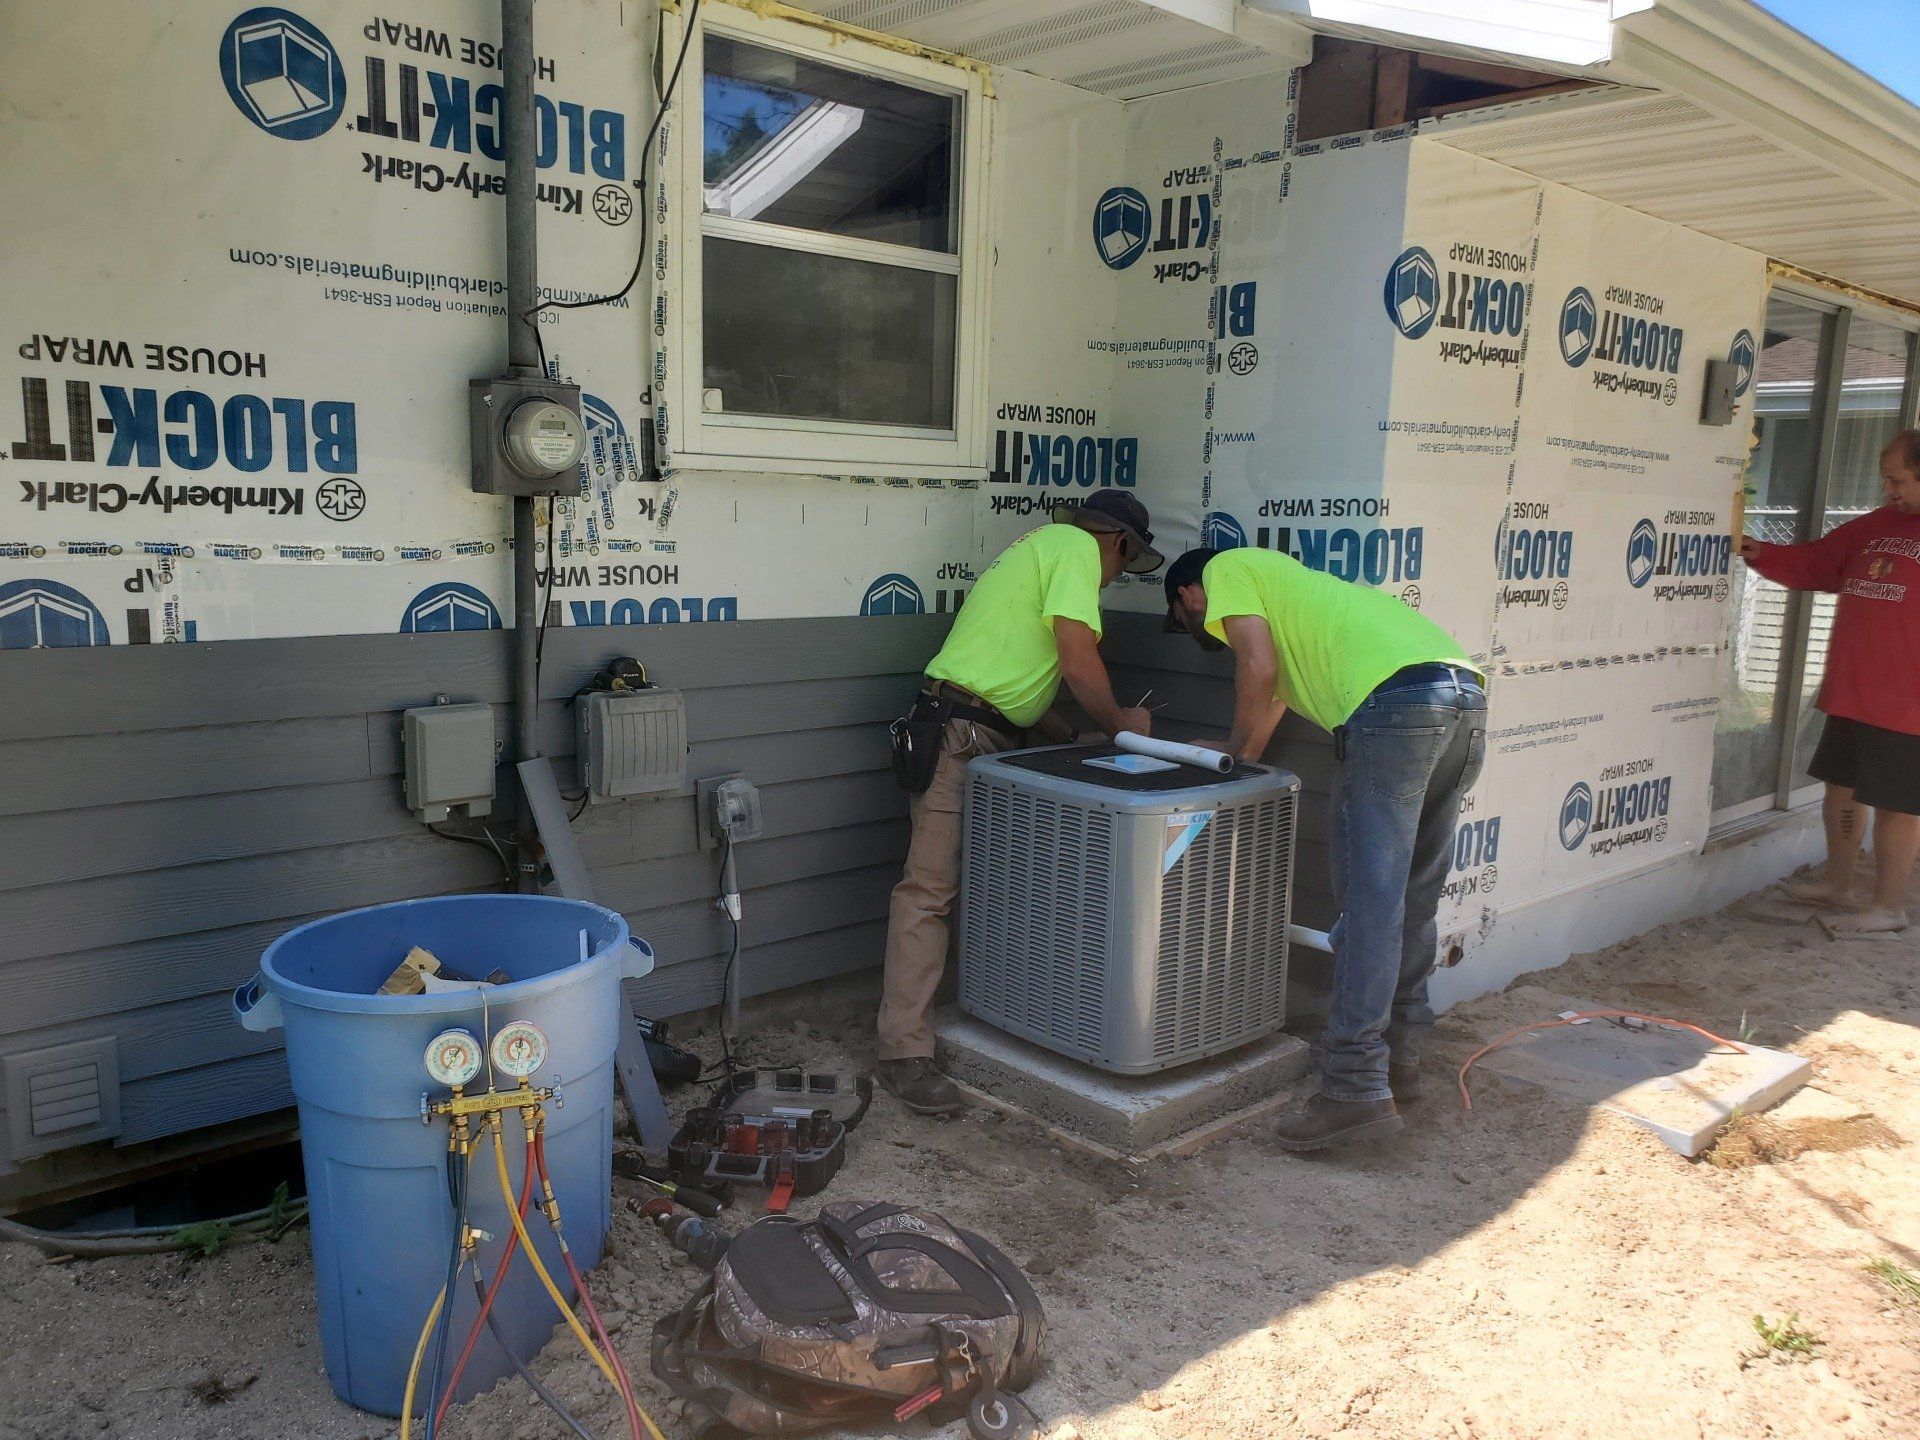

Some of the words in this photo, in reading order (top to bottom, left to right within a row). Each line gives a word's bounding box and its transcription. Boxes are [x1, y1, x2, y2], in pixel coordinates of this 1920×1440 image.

[363, 16, 451, 59] WRAP
[461, 38, 556, 82] HSE
[361, 152, 583, 214] Kimerly-Clark
[1449, 242, 1484, 267] WRAP
[1488, 249, 1526, 274] HOUSE
[229, 248, 629, 310] www.kimbe-clarkbuildingmaterials.com
[324, 287, 391, 308] ESR-3641
[395, 294, 441, 312] Report
[1440, 271, 1525, 337] OCK-IT
[1604, 285, 1632, 307] WRAP
[1634, 293, 1663, 315] HOUSE
[444, 300, 507, 317] valuation
[19, 334, 134, 368] WRAP
[1594, 310, 1683, 374] BLOCK-IT
[144, 343, 266, 377] HOUSE
[1166, 357, 1192, 369] Report
[1439, 340, 1520, 369] imberly-Clark
[1592, 371, 1662, 401] Kimberly-Clark
[997, 403, 1041, 423] WRAP
[1046, 406, 1096, 426] HOUSE
[12, 377, 357, 474] BLOCK-IT
[1379, 420, 1511, 440] berly-clarkbuildingmaterials.com
[989, 430, 1138, 488] BLOCK-IT
[19, 475, 303, 515] Kimberly-Clark
[1258, 498, 1314, 517] WRAP
[1321, 498, 1389, 516] HOUSE
[1513, 502, 1549, 520] HOUSE
[1664, 510, 1687, 524] WRAP
[1688, 511, 1715, 526] HOUSE
[0, 547, 30, 557] OCK-IT
[1655, 533, 1731, 576] BLOCK-IT
[534, 566, 590, 588] WRA
[598, 564, 678, 586] HOUSE
[1502, 585, 1550, 609] Kimberly
[1652, 581, 1713, 602] Kimberly-Clark
[1599, 764, 1624, 782] WRAP
[1625, 758, 1653, 776] HOUSE
[1591, 776, 1671, 833] BLOCK-IT
[1589, 827, 1653, 858] Kimberly-Clark
